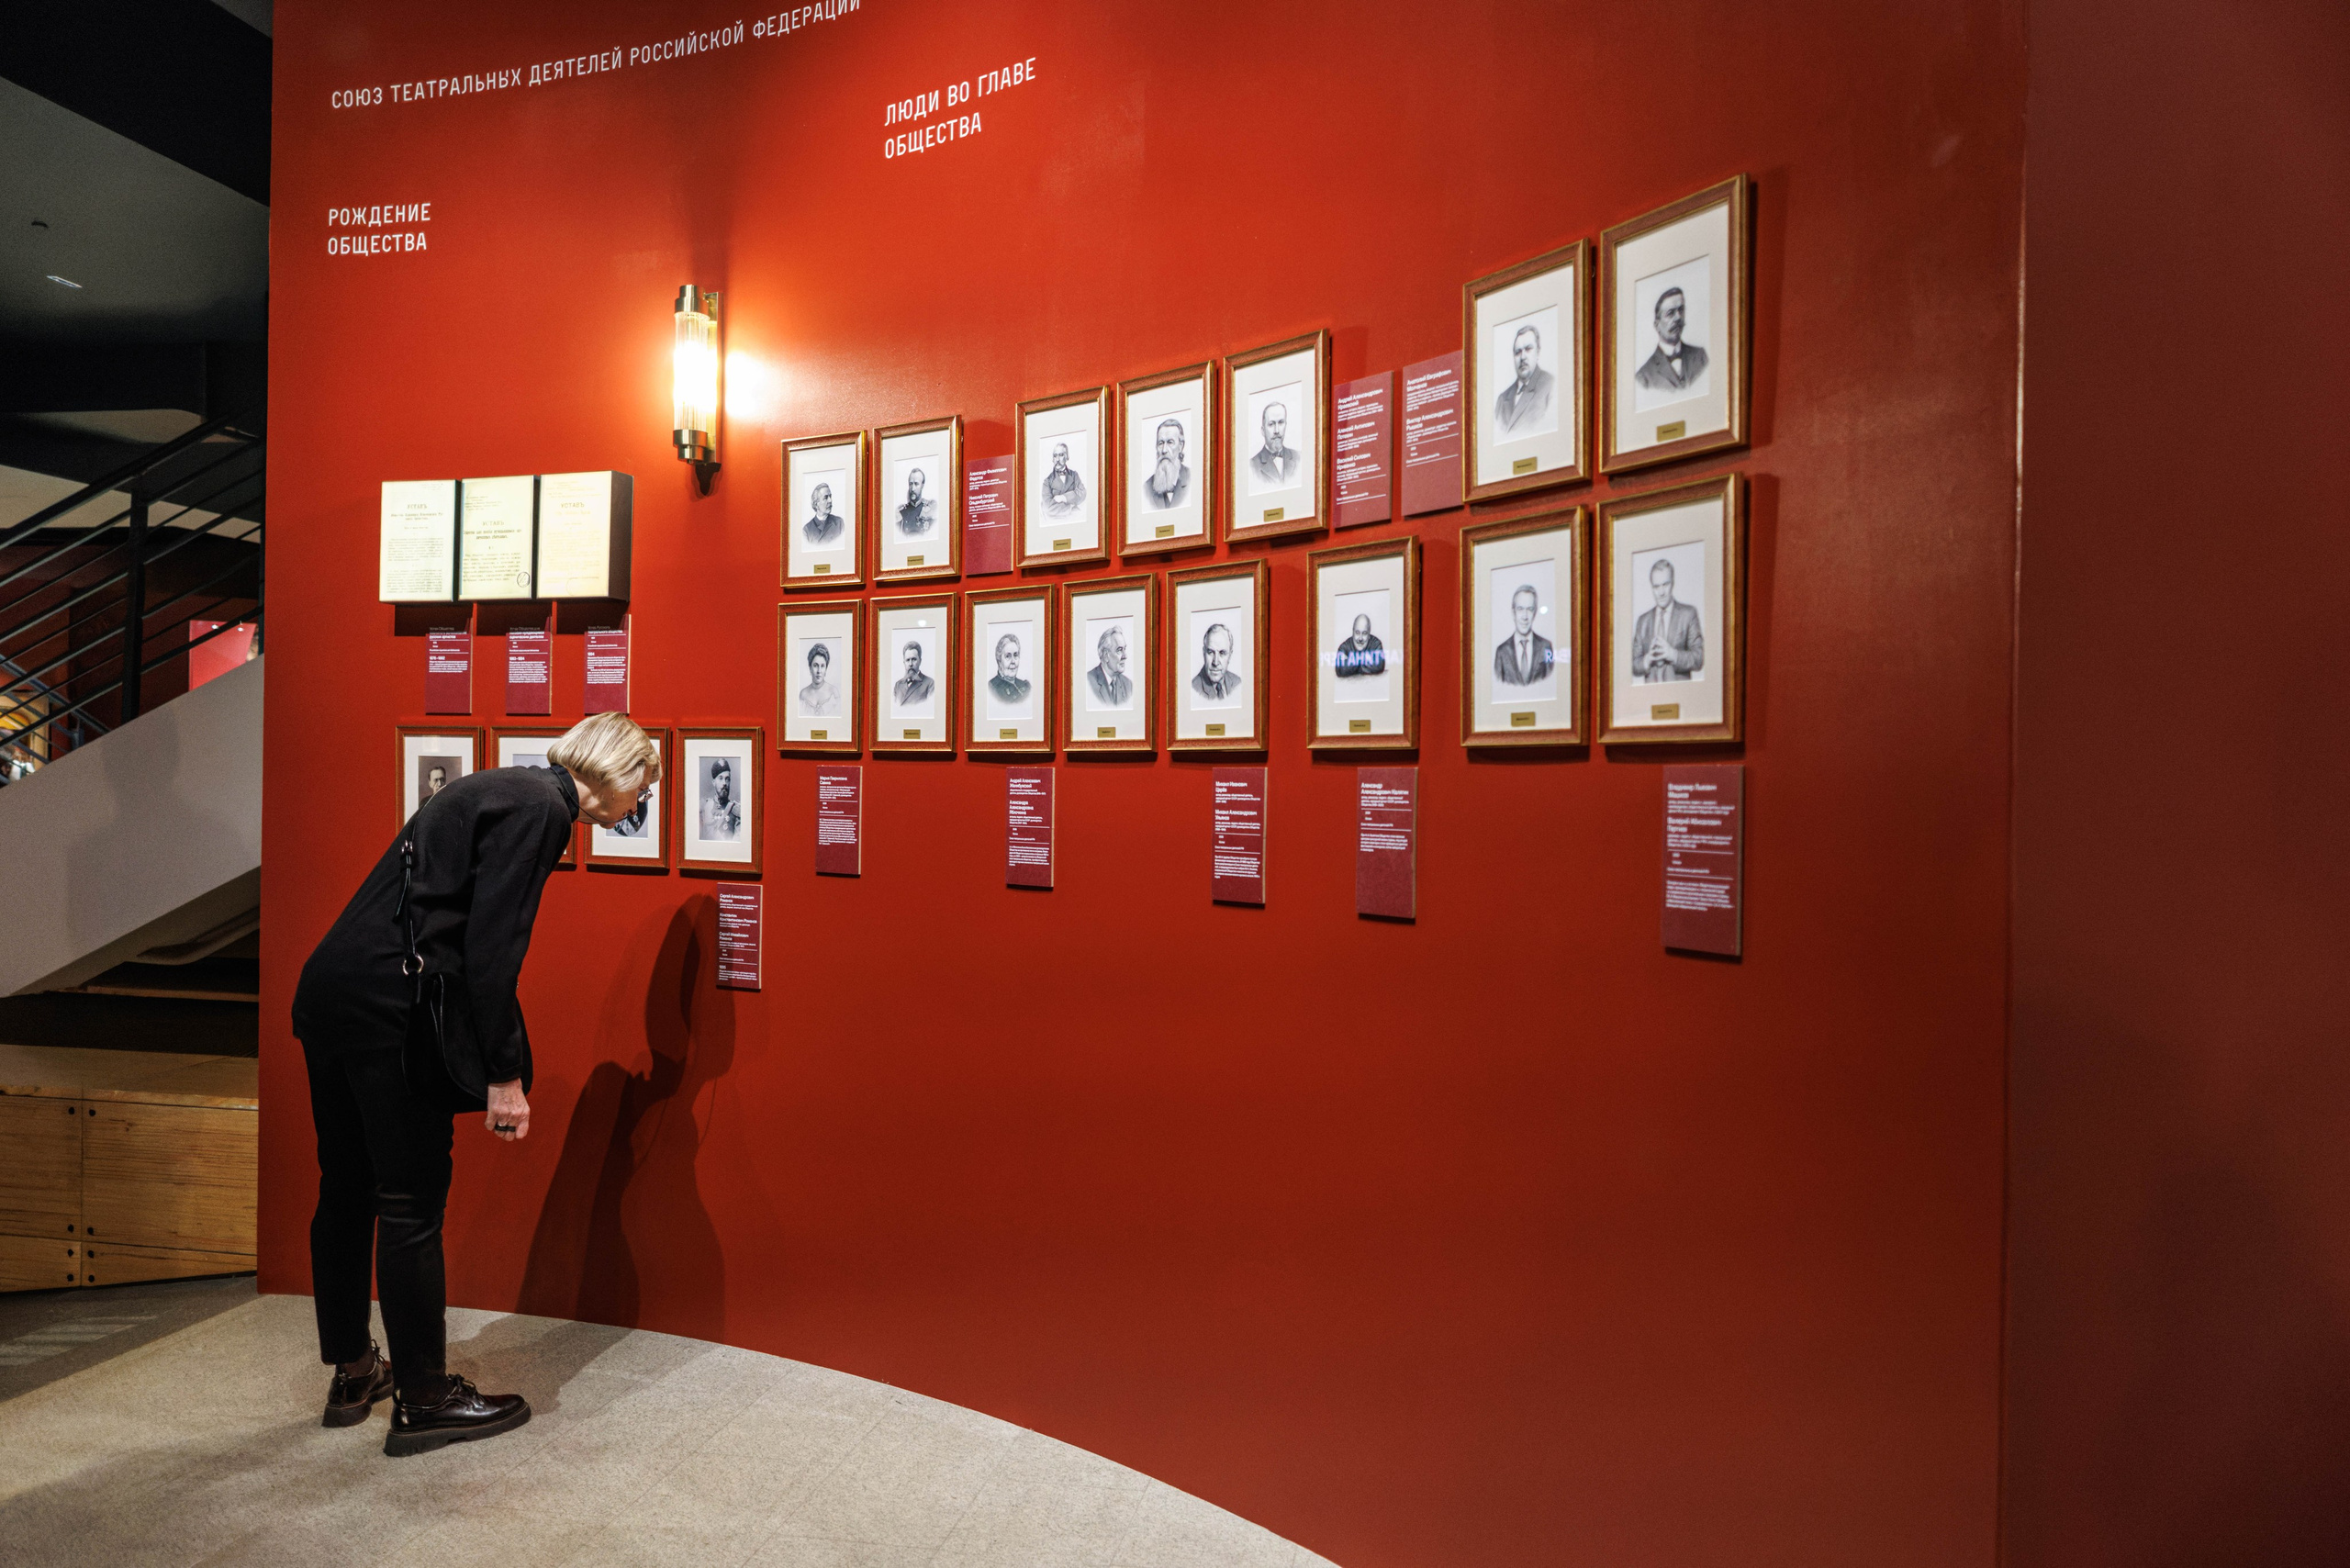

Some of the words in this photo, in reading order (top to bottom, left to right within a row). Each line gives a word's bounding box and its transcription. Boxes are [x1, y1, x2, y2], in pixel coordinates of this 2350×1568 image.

[331, 86, 383, 108] СОЮЗ
[529, 47, 622, 87] ДЕЯТЕЛЕЙ
[630, 20, 744, 66] РОССИЙСКОЙ
[884, 90, 939, 127] ЛЮДИ
[947, 81, 969, 107] ВО
[978, 57, 1036, 97] ГЛАВЕ
[885, 112, 982, 159] ОБЩЕСТВА
[329, 202, 431, 228] РОЖДЕНИЕ
[328, 232, 427, 257] ОБЩЕСТВА
